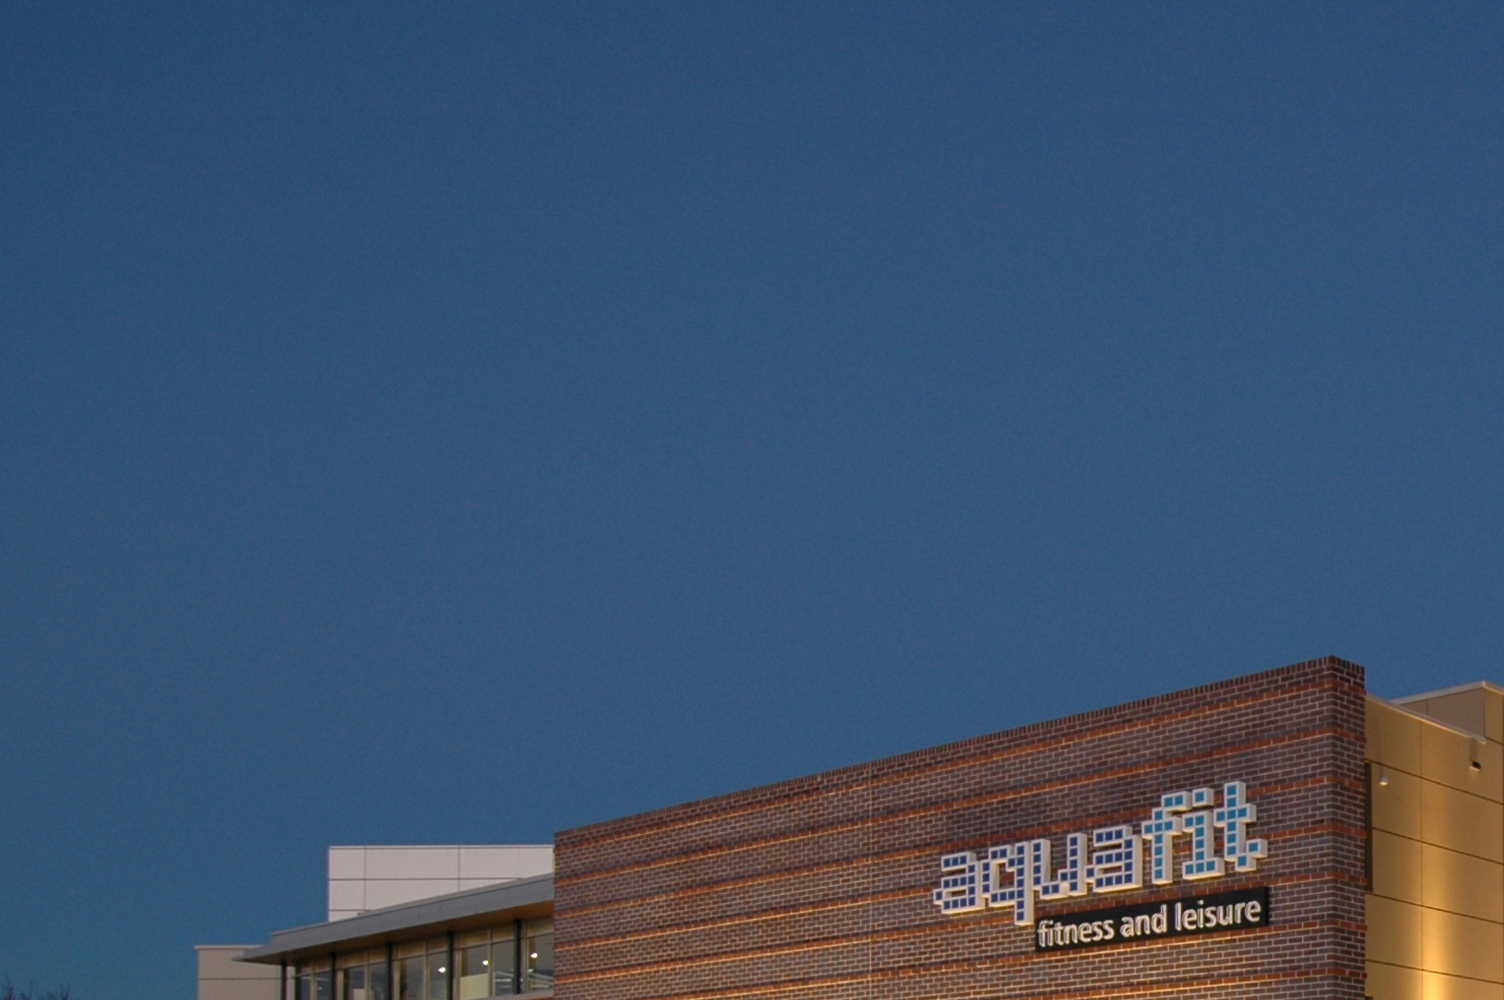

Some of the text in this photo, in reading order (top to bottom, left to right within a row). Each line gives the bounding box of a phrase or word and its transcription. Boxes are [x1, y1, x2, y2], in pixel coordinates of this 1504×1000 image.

[933, 781, 1268, 926] aquafit
[1037, 900, 1262, 948] fitness and leisure
